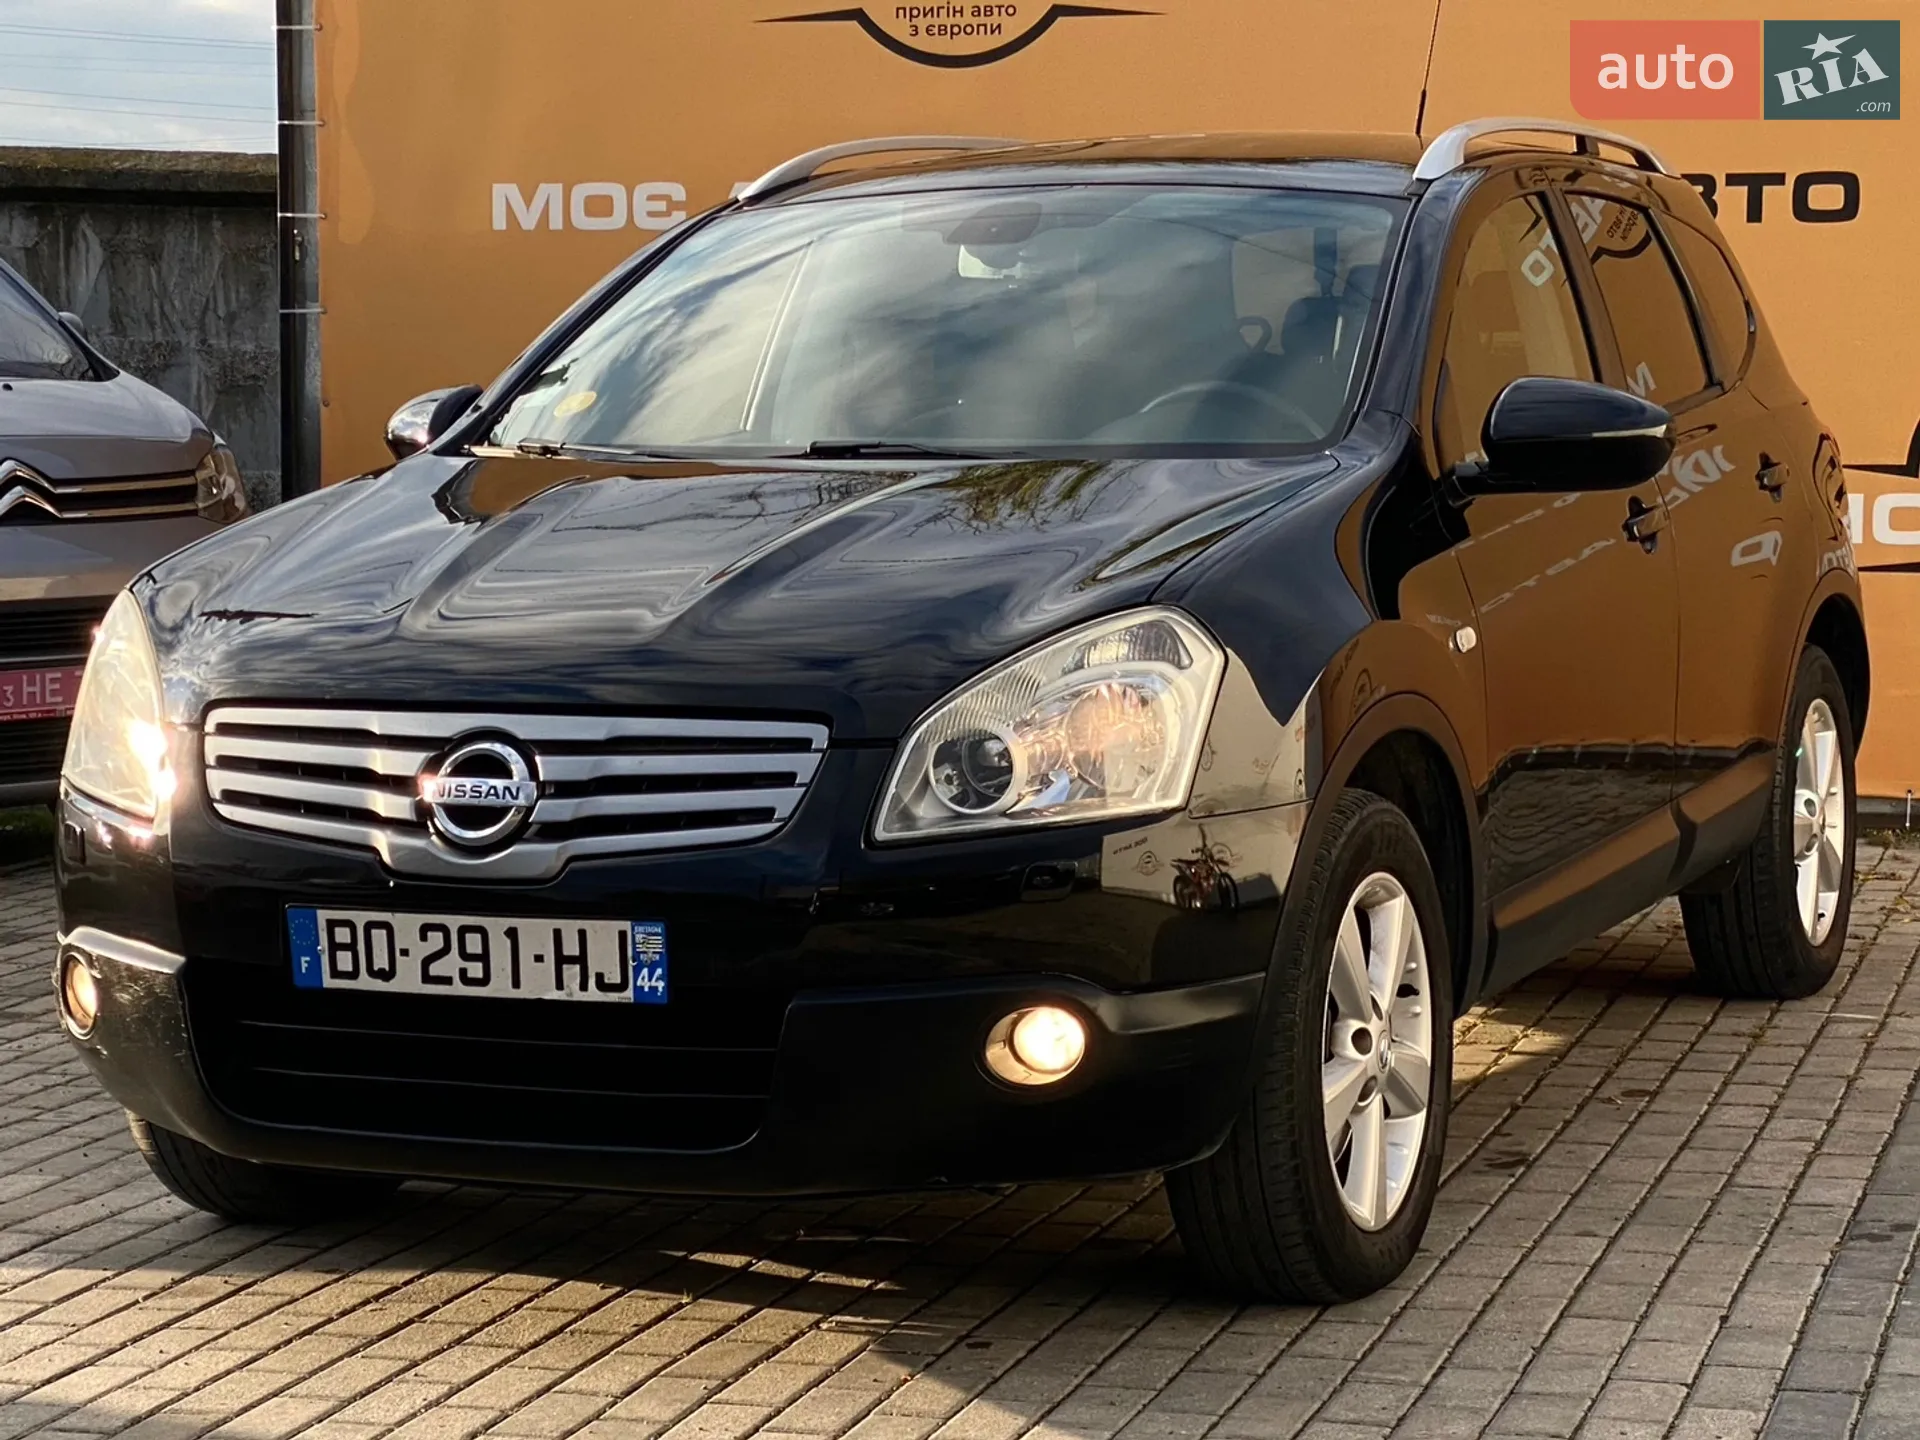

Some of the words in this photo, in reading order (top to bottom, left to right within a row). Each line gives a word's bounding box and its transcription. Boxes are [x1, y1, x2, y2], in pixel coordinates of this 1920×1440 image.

[895, 0, 964, 22] пригін
[970, 4, 1017, 18] авто
[909, 24, 919, 37] з
[925, 23, 1002, 40] європи
[492, 182, 686, 230] МОЄ
[3, 685, 14, 707] 3
[437, 784, 520, 800] NISSAN
[301, 956, 310, 973] F
[325, 918, 629, 994] BQ-291-HJ
[637, 967, 665, 993] 44
